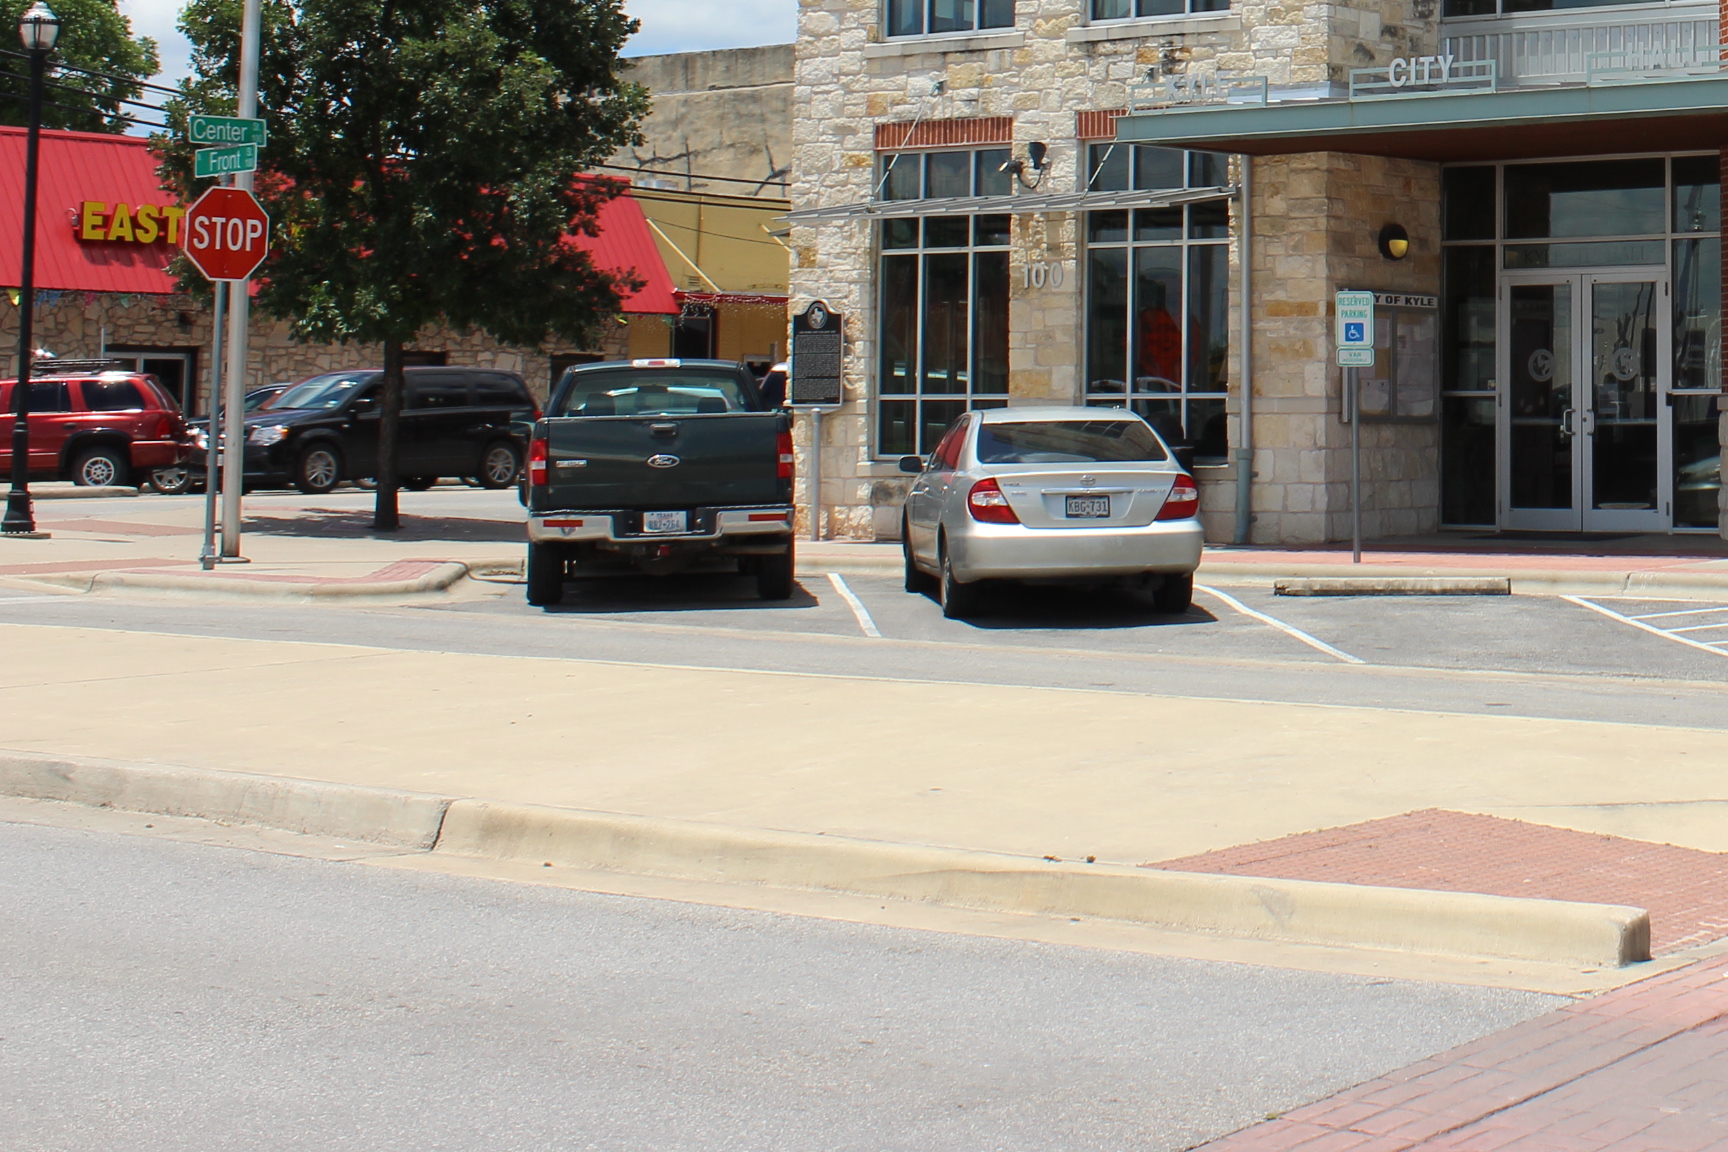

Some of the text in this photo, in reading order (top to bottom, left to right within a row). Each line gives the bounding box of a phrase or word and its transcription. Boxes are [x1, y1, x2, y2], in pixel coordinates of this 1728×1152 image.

[1627, 38, 1703, 70] HALL
[1389, 55, 1454, 88] CITY
[1165, 72, 1229, 100] KYLE
[193, 119, 248, 141] Center
[210, 150, 241, 171] Front
[82, 201, 185, 244] EAST
[193, 216, 263, 251] STOP
[1021, 261, 1063, 288] 100
[1338, 297, 1370, 306] RESERVED
[1385, 295, 1401, 304] OF
[1404, 296, 1435, 306] KYLE
[1340, 310, 1368, 318] PARKING
[1068, 501, 1108, 512] KBG-731
